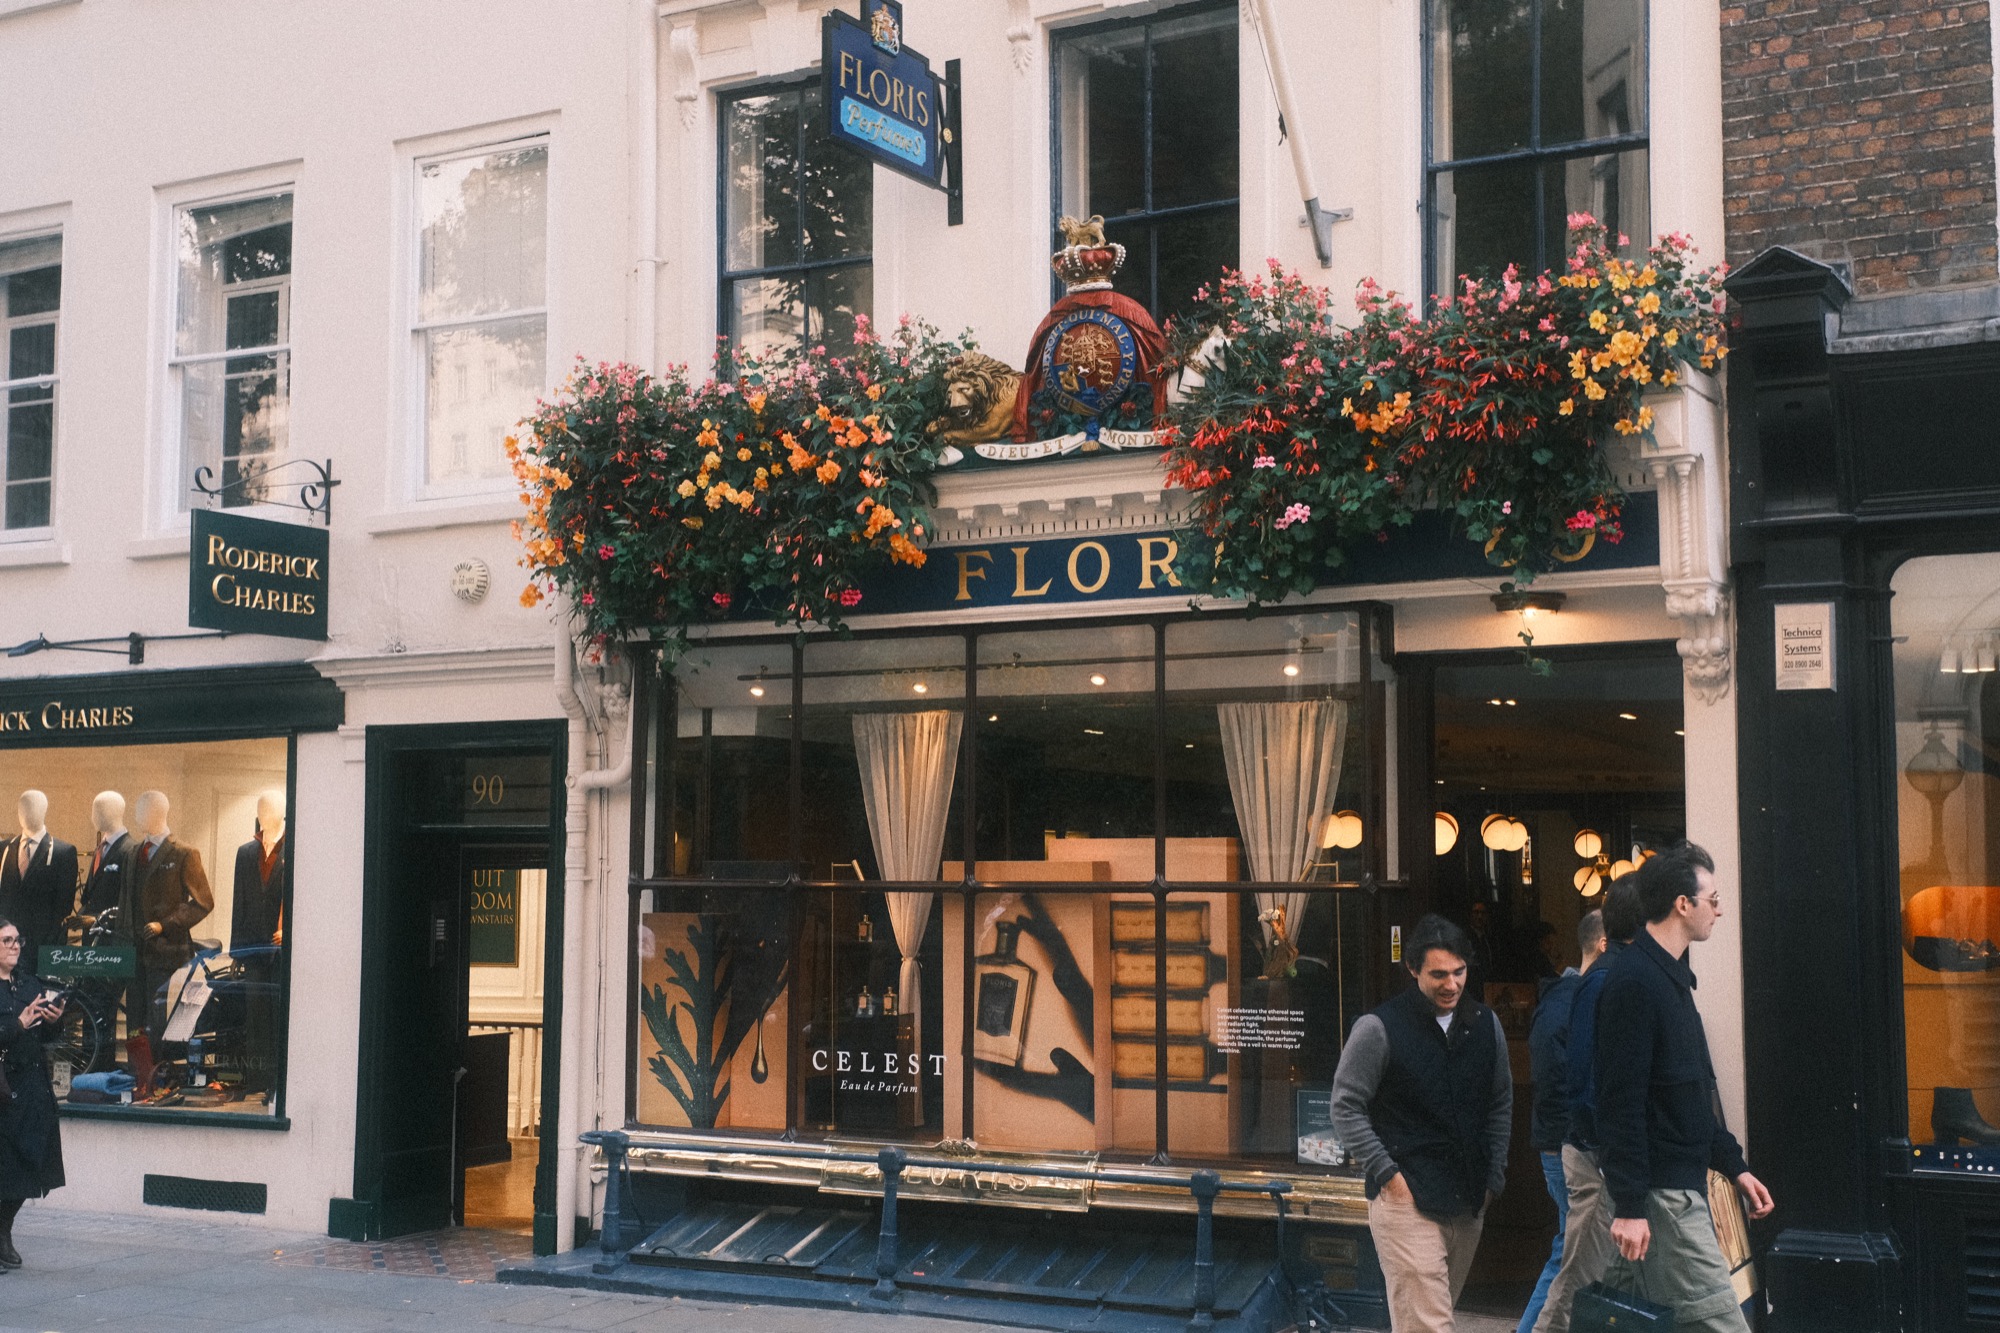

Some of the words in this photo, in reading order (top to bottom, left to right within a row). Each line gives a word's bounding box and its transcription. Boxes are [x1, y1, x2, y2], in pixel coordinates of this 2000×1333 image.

[840, 50, 929, 127] FLORIS
[1069, 309, 1095, 322] QUI
[1100, 312, 1130, 344] MAL
[1122, 350, 1134, 362] Y
[986, 445, 1031, 459] DIEU
[1042, 438, 1066, 455] ET
[1106, 432, 1138, 446] MON
[207, 533, 320, 580] RODERICK
[211, 573, 316, 615] CHARLES
[1784, 644, 1822, 655] Systems
[41, 701, 134, 729] CHARLES
[472, 774, 504, 805] 90
[50, 950, 74, 965] Back
[75, 951, 83, 963] to
[84, 950, 122, 965] Business
[812, 1049, 947, 1076] CELEST
[840, 1080, 861, 1090] Eau
[864, 1081, 875, 1091] de
[877, 1081, 918, 1096] Parfum
